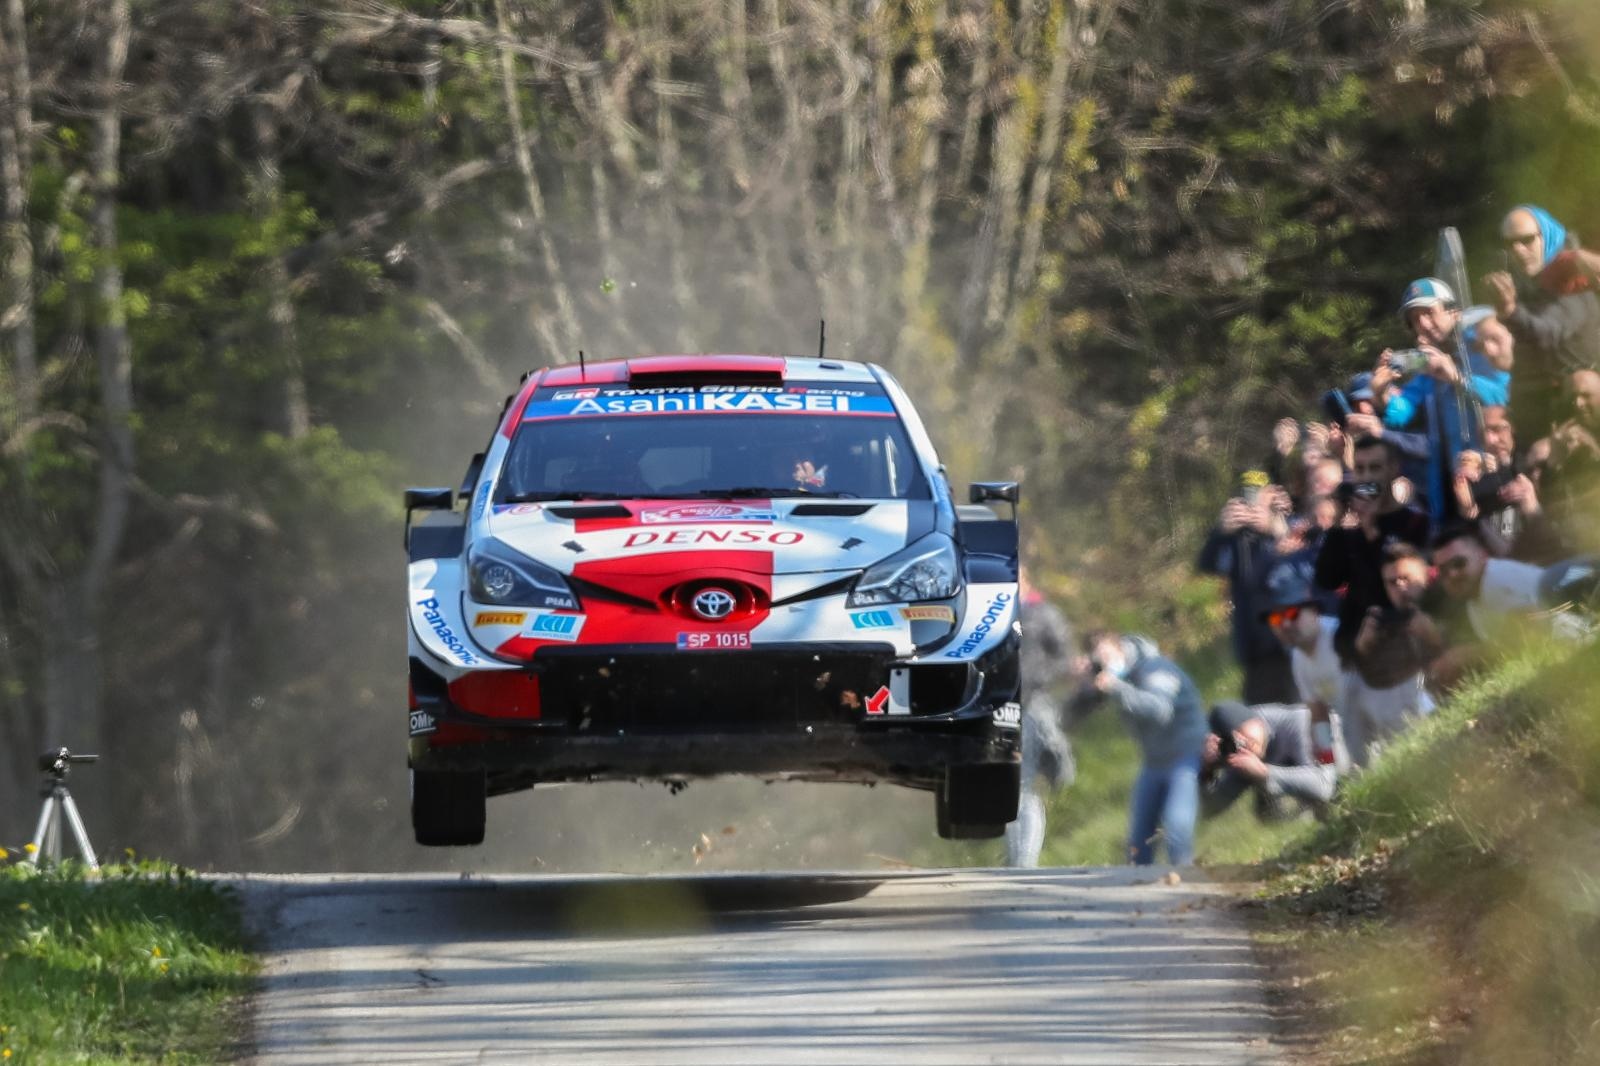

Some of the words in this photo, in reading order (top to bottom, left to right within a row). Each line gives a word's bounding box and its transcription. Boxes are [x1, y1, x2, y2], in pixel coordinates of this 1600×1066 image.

[555, 388, 598, 400] GR
[604, 387, 694, 396] TOYOTA
[699, 385, 784, 393] GAZOO
[788, 387, 866, 397] Racing
[623, 530, 804, 548] DENSO
[416, 597, 479, 665] Panasonic
[944, 592, 1011, 658] Panasonic
[688, 633, 711, 648] SP
[715, 633, 748, 647] 1015
[993, 706, 1020, 721] OMP
